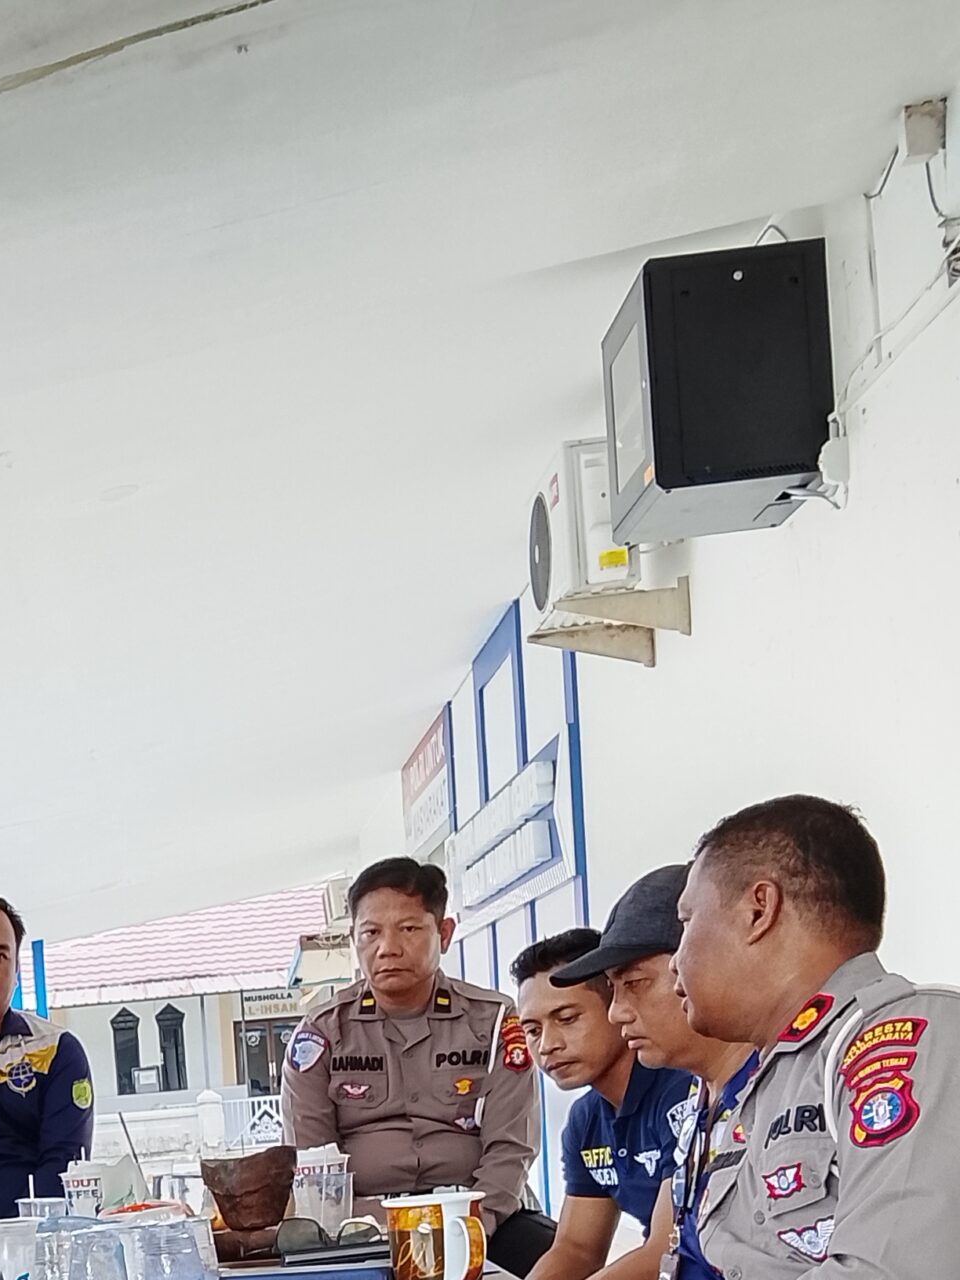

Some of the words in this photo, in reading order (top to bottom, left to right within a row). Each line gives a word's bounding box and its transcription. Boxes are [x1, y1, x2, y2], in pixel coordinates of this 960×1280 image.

[244, 992, 293, 1002] MUSHOLLA
[246, 1003, 297, 1015] L-IHSAN
[436, 1050, 488, 1067] POLRI
